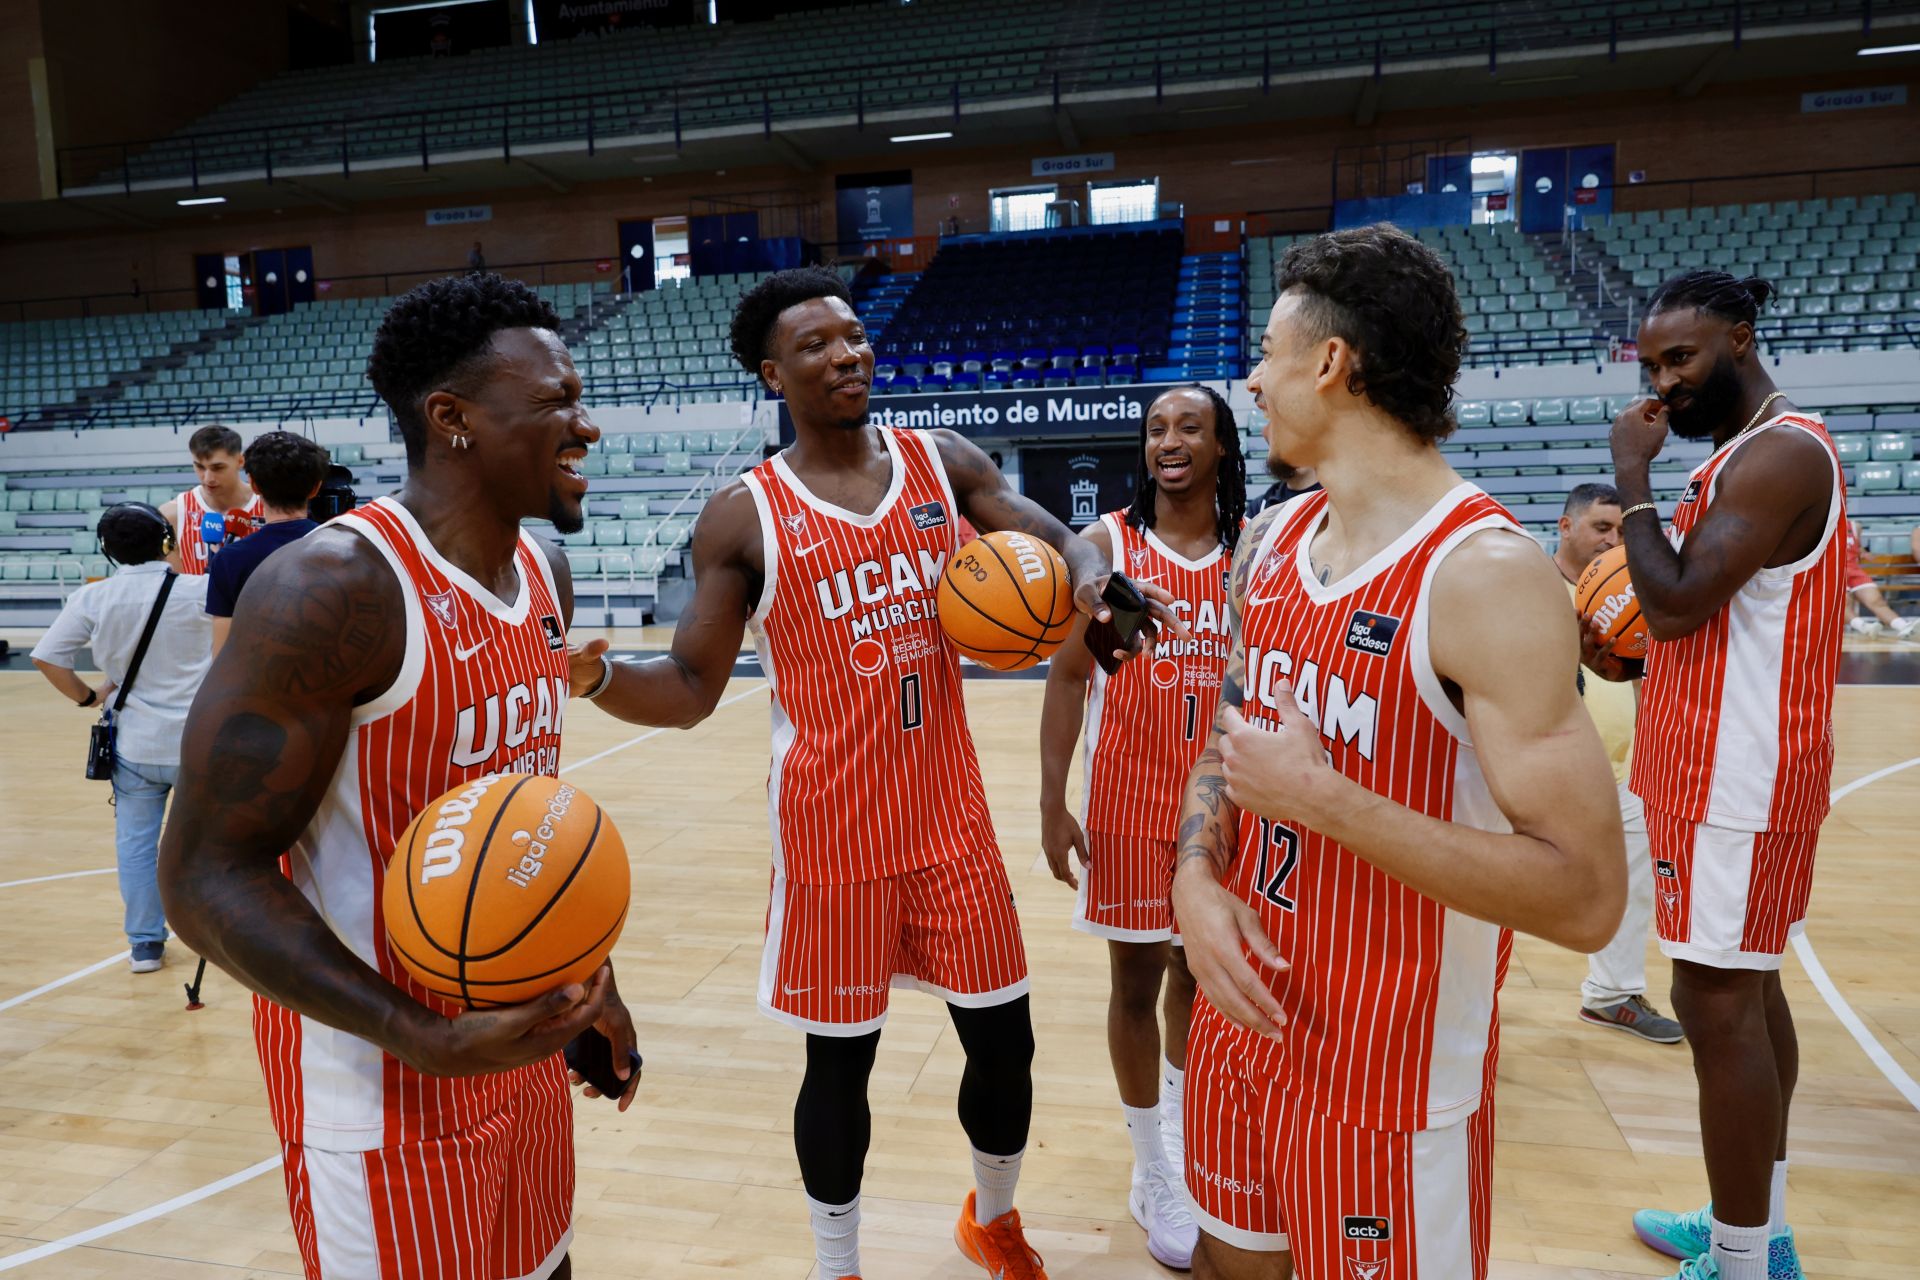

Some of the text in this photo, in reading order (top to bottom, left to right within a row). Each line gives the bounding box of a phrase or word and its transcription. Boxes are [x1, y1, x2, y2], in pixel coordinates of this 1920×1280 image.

[1042, 157, 1104, 171] Grada Sur
[869, 394, 1142, 428] ntamiento de Murcia
[205, 520, 222, 532] tve
[815, 549, 947, 620] UCAM
[1578, 567, 1599, 595] acb
[1591, 582, 1636, 635] Wilso
[1352, 621, 1371, 637] liga
[1154, 638, 1229, 661] MURCIA
[1349, 634, 1389, 651] endesa
[894, 653, 908, 665] DE
[1184, 679, 1196, 687] DE
[900, 672, 923, 732] 0
[1184, 693, 1197, 741] 1
[507, 783, 577, 888] liga endesa
[1254, 815, 1299, 913] 12
[834, 981, 885, 996] INVERSUS
[1194, 1159, 1264, 1196] INVERSUS
[1348, 1225, 1380, 1237] acb
